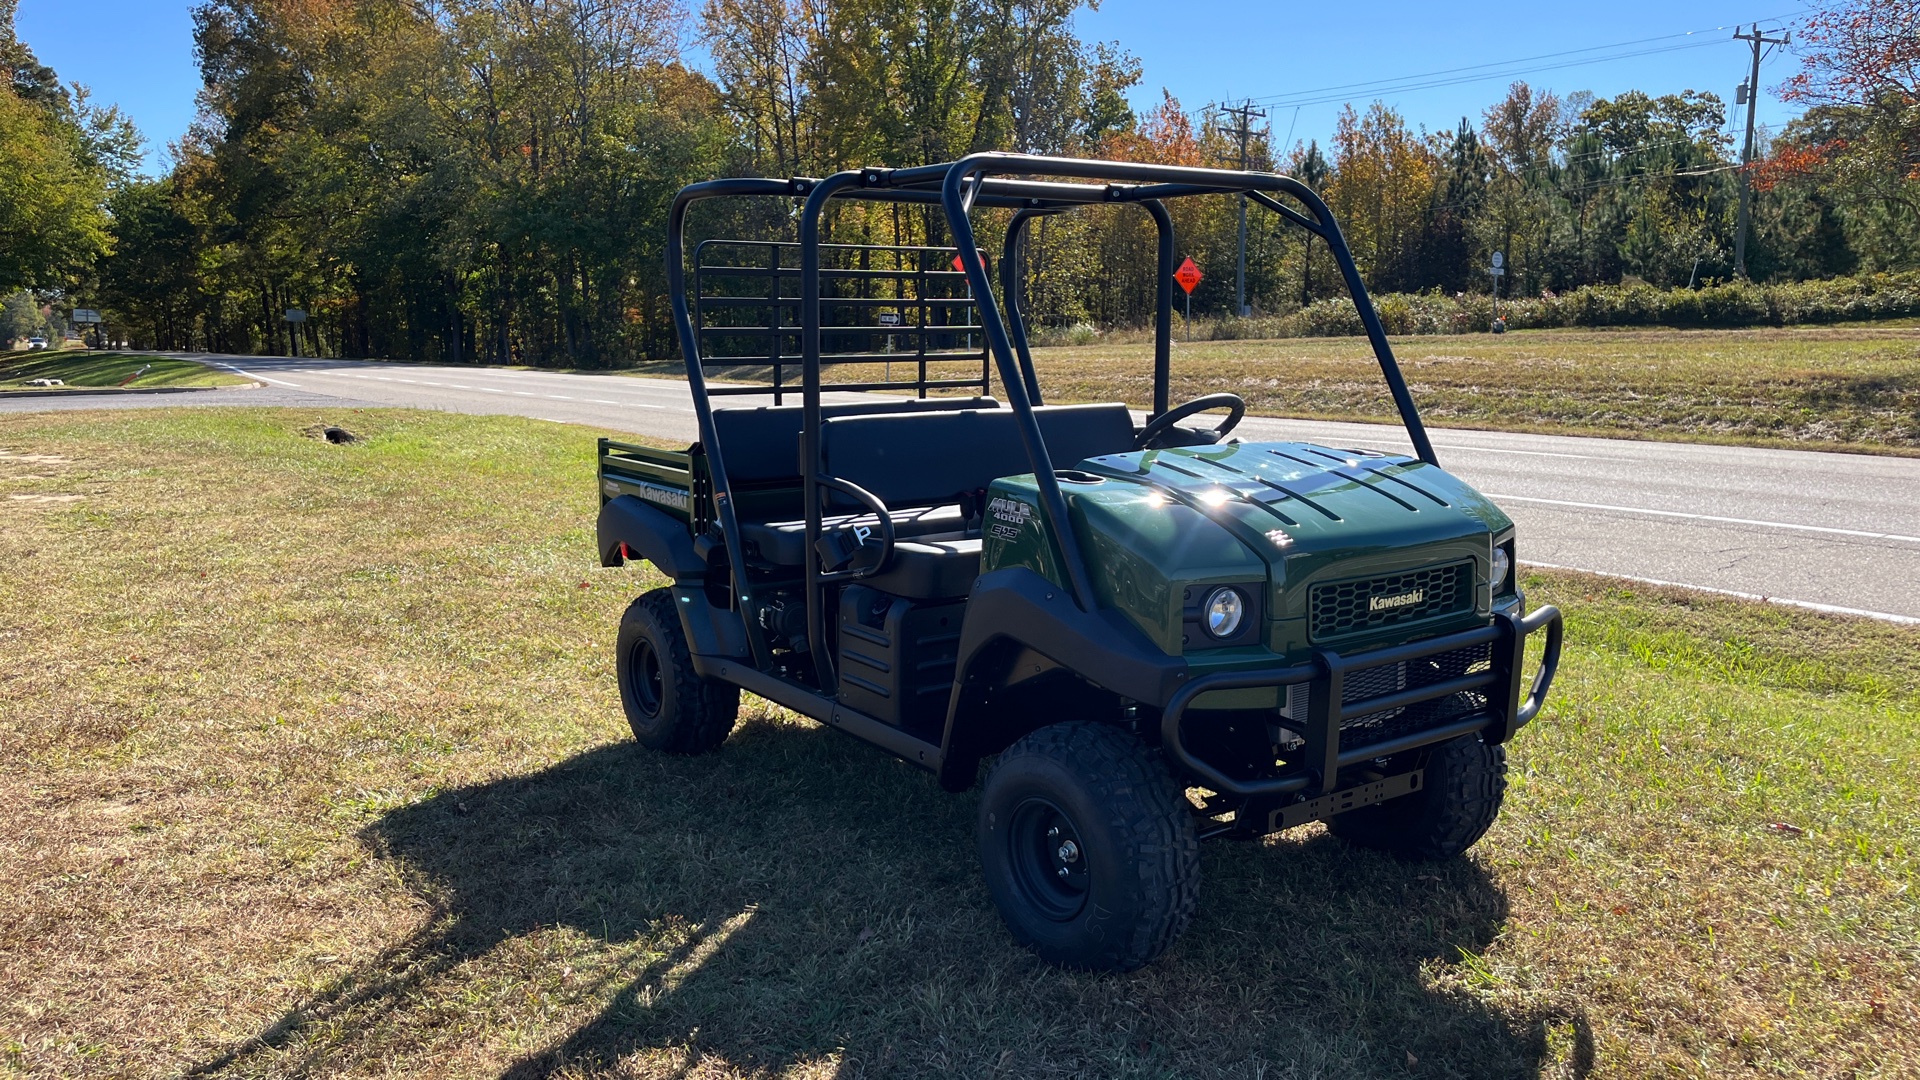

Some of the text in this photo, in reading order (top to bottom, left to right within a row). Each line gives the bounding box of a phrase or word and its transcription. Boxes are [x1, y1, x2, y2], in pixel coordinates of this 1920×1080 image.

[639, 481, 688, 509] Kawasaki
[988, 497, 1031, 519] MULE
[993, 512, 1024, 525] 4000
[990, 523, 1019, 539] EPS
[1369, 588, 1424, 611] Kawasaki
